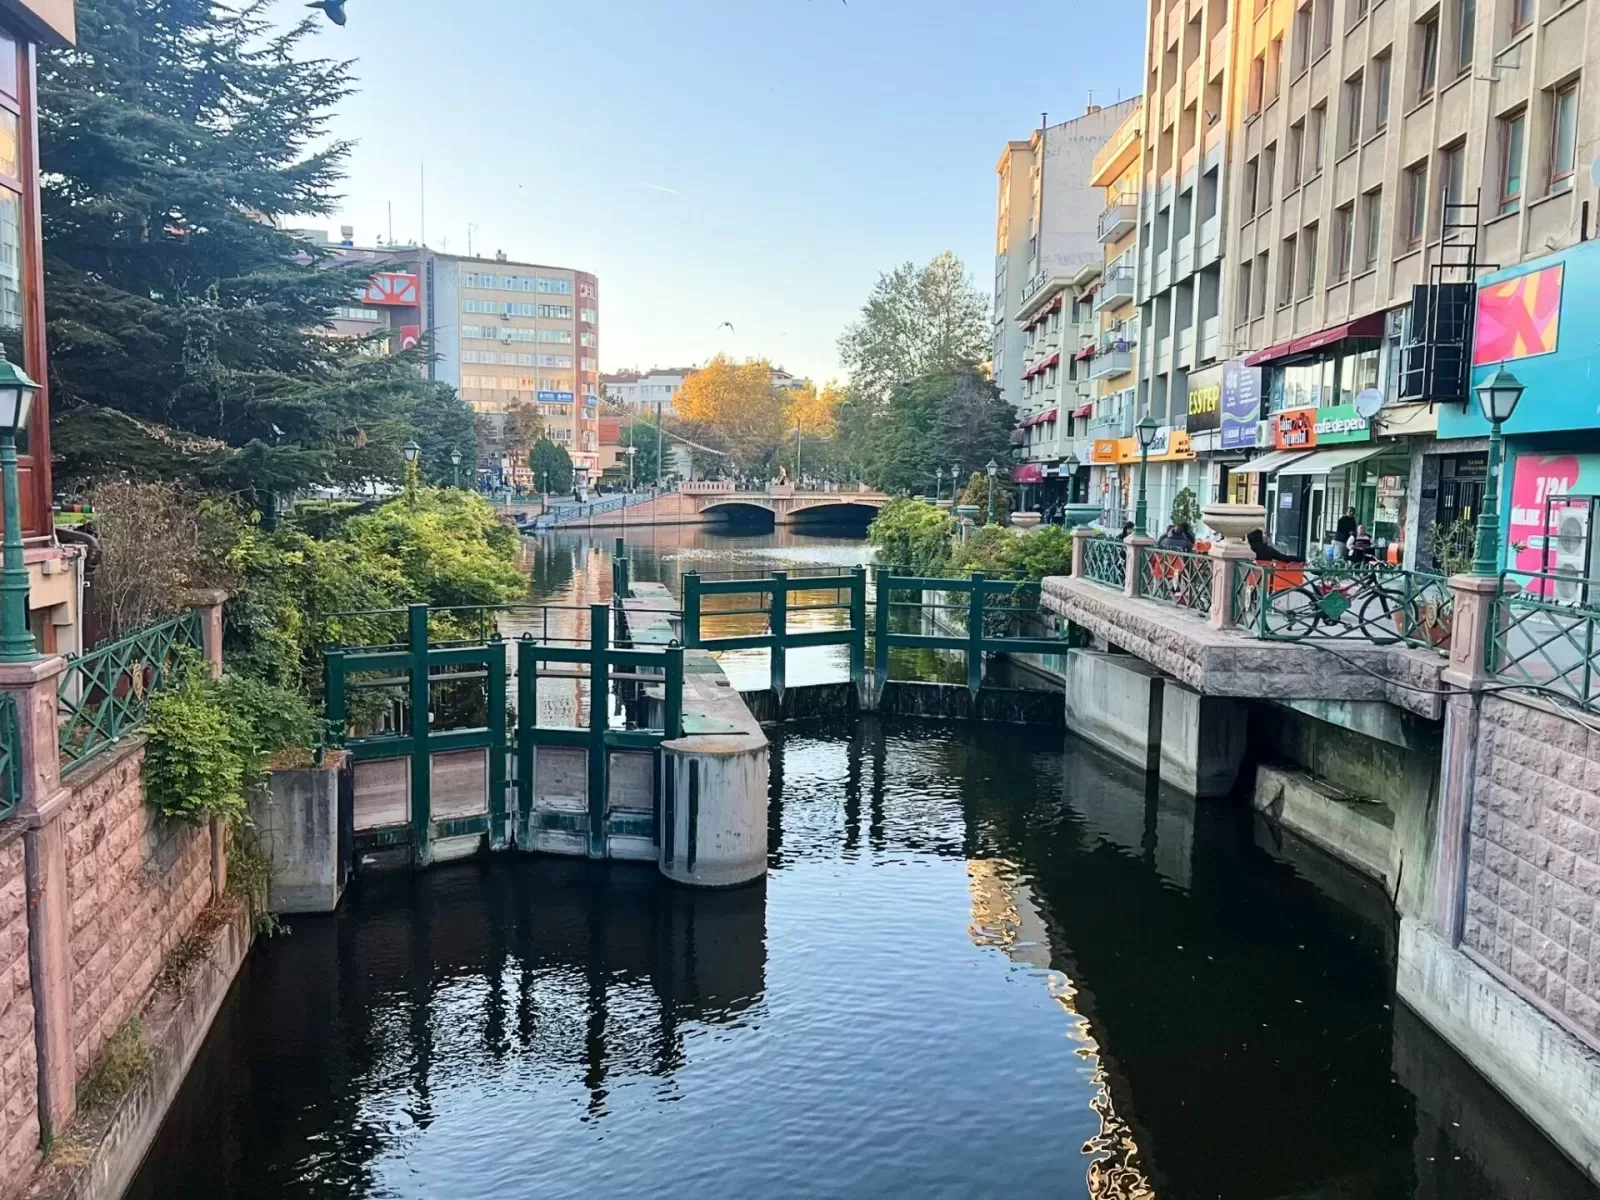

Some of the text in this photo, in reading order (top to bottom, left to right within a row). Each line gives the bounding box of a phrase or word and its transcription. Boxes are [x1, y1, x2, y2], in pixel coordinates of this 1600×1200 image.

[1189, 386, 1220, 415] ESSTEP
[1333, 418, 1344, 432] de
[1344, 417, 1366, 435] pera
[1535, 476, 1568, 505] 7/24
